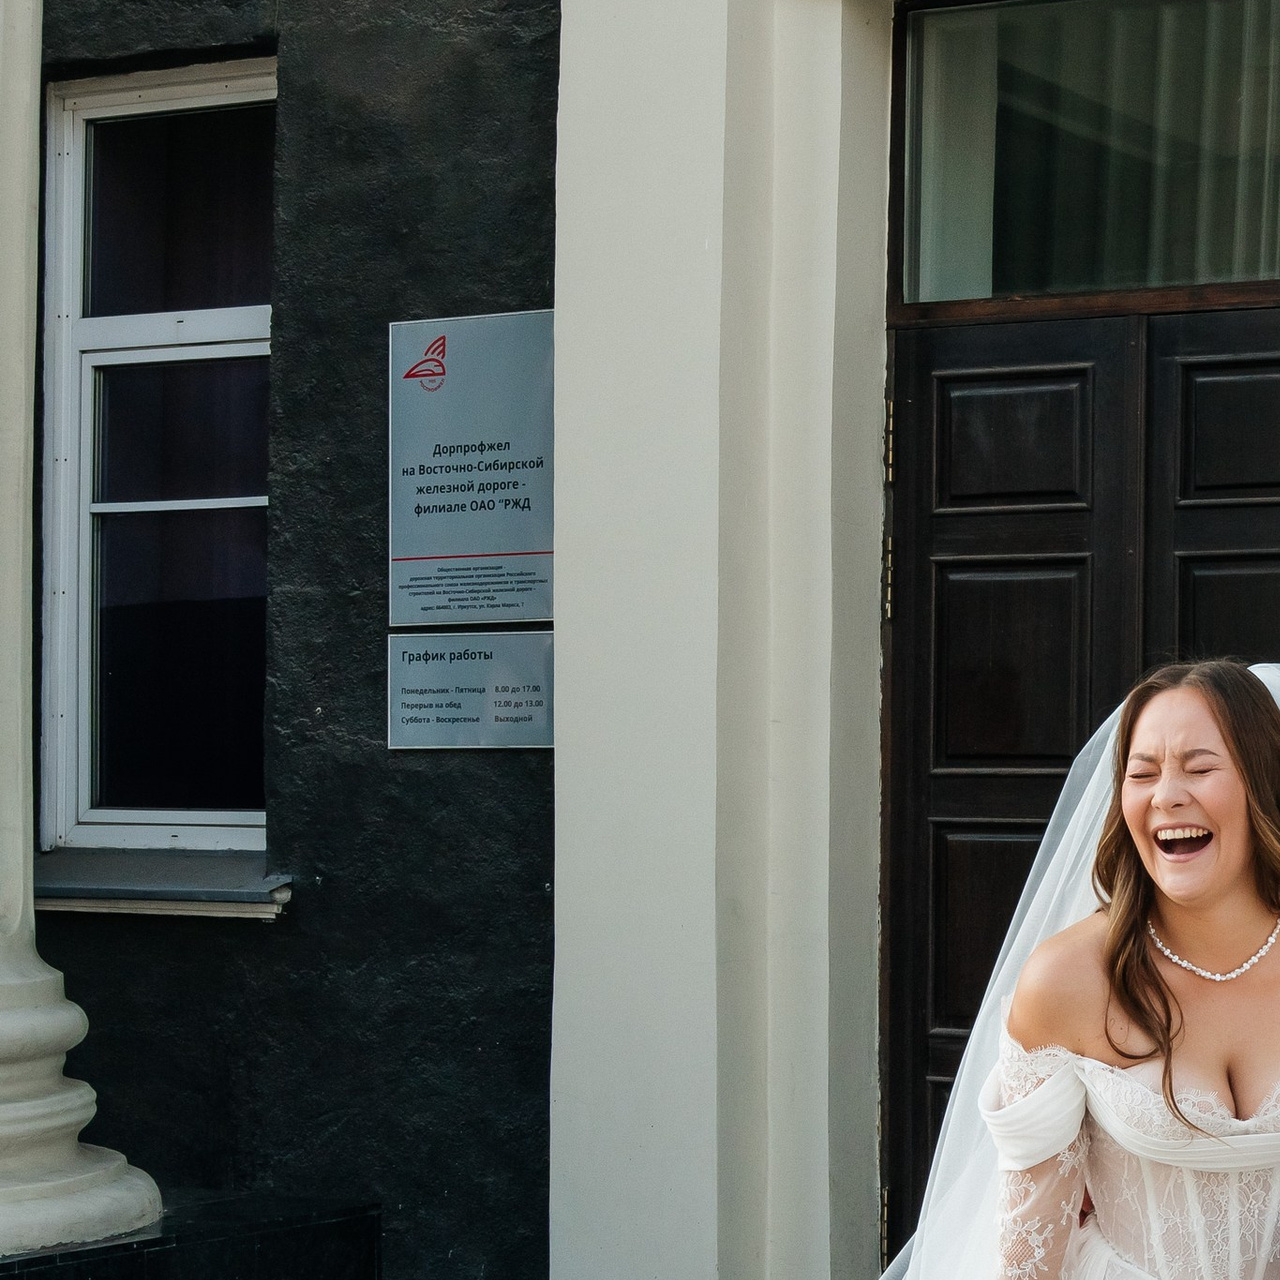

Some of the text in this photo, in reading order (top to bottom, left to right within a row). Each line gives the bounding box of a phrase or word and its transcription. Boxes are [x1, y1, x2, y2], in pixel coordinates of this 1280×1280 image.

[433, 441, 511, 457] Дорпрофжел
[402, 456, 544, 476] на Восточно-Сибирской
[416, 480, 475, 495] железной
[477, 480, 519, 494] дороге
[414, 503, 467, 517] филиале
[470, 499, 496, 511] ОАО
[402, 649, 493, 665] График работы
[401, 687, 450, 696] Понедельник
[455, 686, 486, 694] Пятница
[494, 685, 510, 693] 8.00
[522, 685, 541, 693] 17.00
[401, 702, 434, 710] Перерыв
[445, 701, 462, 709] обед
[494, 700, 513, 708] 12.00
[513, 701, 523, 709] до
[401, 716, 431, 725] Суббота
[435, 716, 480, 724] Воскресенье
[494, 714, 533, 723] Выходной
